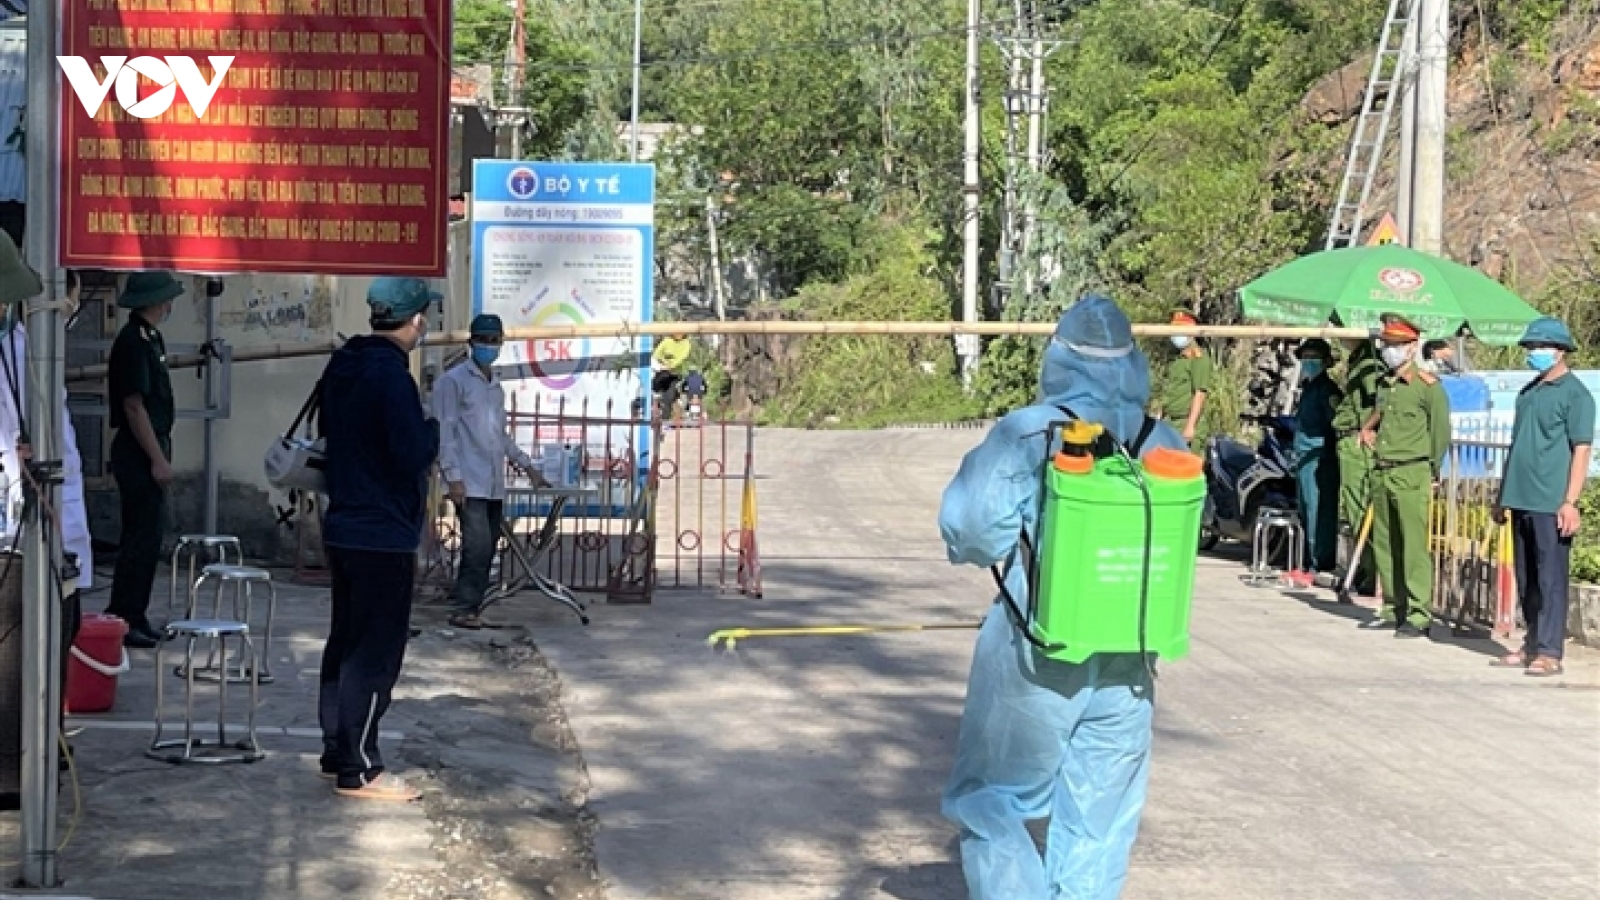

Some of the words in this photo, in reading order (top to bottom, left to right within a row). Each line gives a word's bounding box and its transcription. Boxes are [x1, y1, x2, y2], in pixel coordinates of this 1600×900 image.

[545, 174, 571, 197] BỘ
[578, 178, 590, 193] Y
[595, 174, 620, 194] TẾ
[544, 340, 572, 361] 5K
